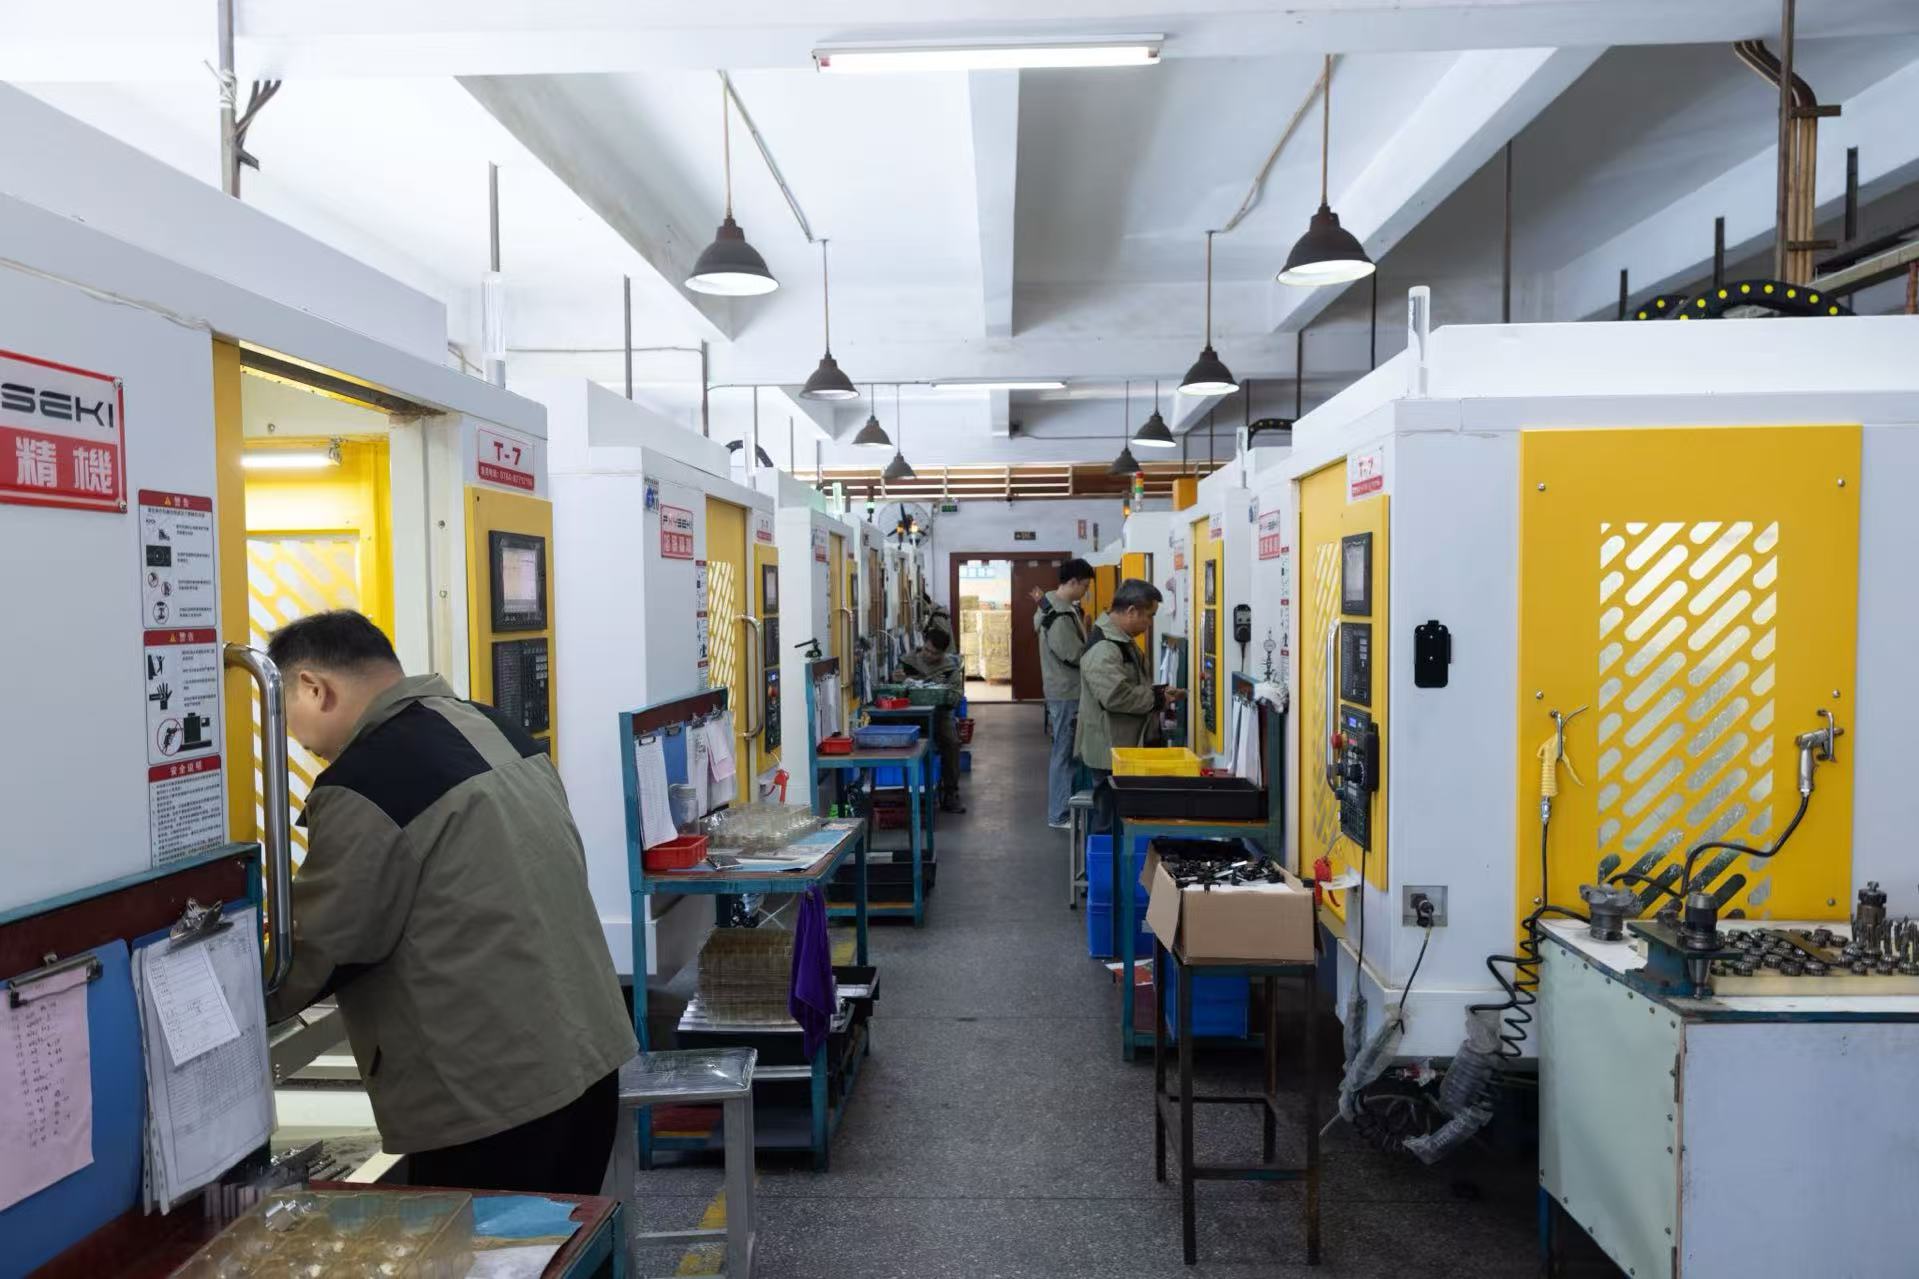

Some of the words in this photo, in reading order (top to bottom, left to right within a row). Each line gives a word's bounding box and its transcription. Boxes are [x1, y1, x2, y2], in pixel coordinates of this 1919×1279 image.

[1, 382, 115, 428] SEKI
[15, 436, 113, 494] 精機
[493, 440, 522, 466] T-7
